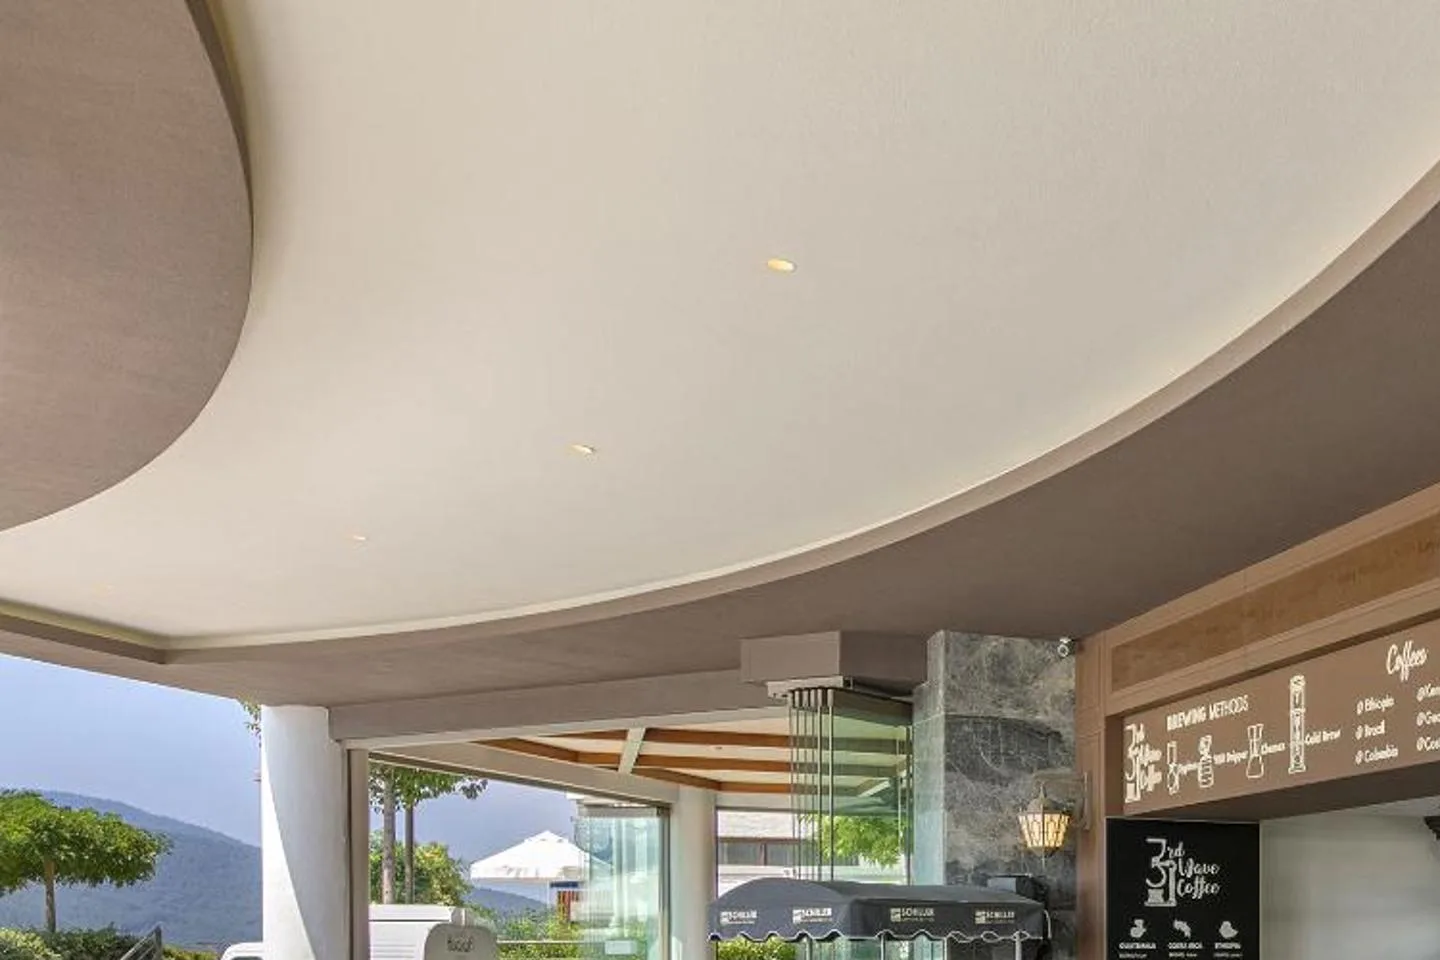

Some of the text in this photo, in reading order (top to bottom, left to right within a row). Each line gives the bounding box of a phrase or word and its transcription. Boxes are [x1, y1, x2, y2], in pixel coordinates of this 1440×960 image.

[1166, 694, 1249, 732] BREWING METHODS
[1176, 875, 1221, 899] Coffee
